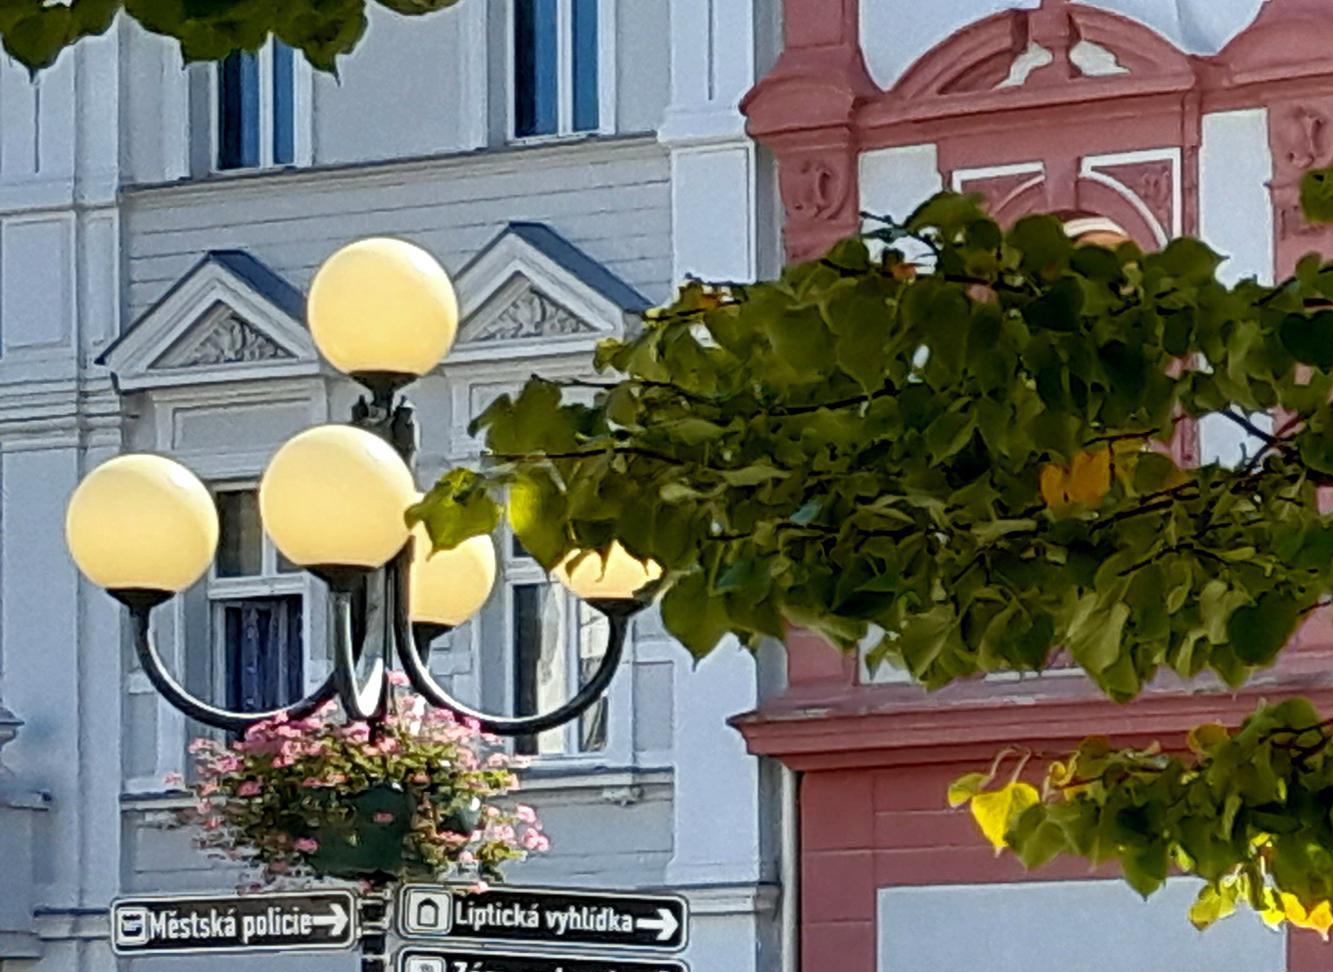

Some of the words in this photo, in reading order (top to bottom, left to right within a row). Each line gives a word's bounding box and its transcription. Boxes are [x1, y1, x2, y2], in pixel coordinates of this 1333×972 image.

[150, 906, 236, 940] Městská
[242, 905, 314, 944] policie
[455, 900, 540, 931] Liptická
[545, 905, 634, 936] vyhlídka
